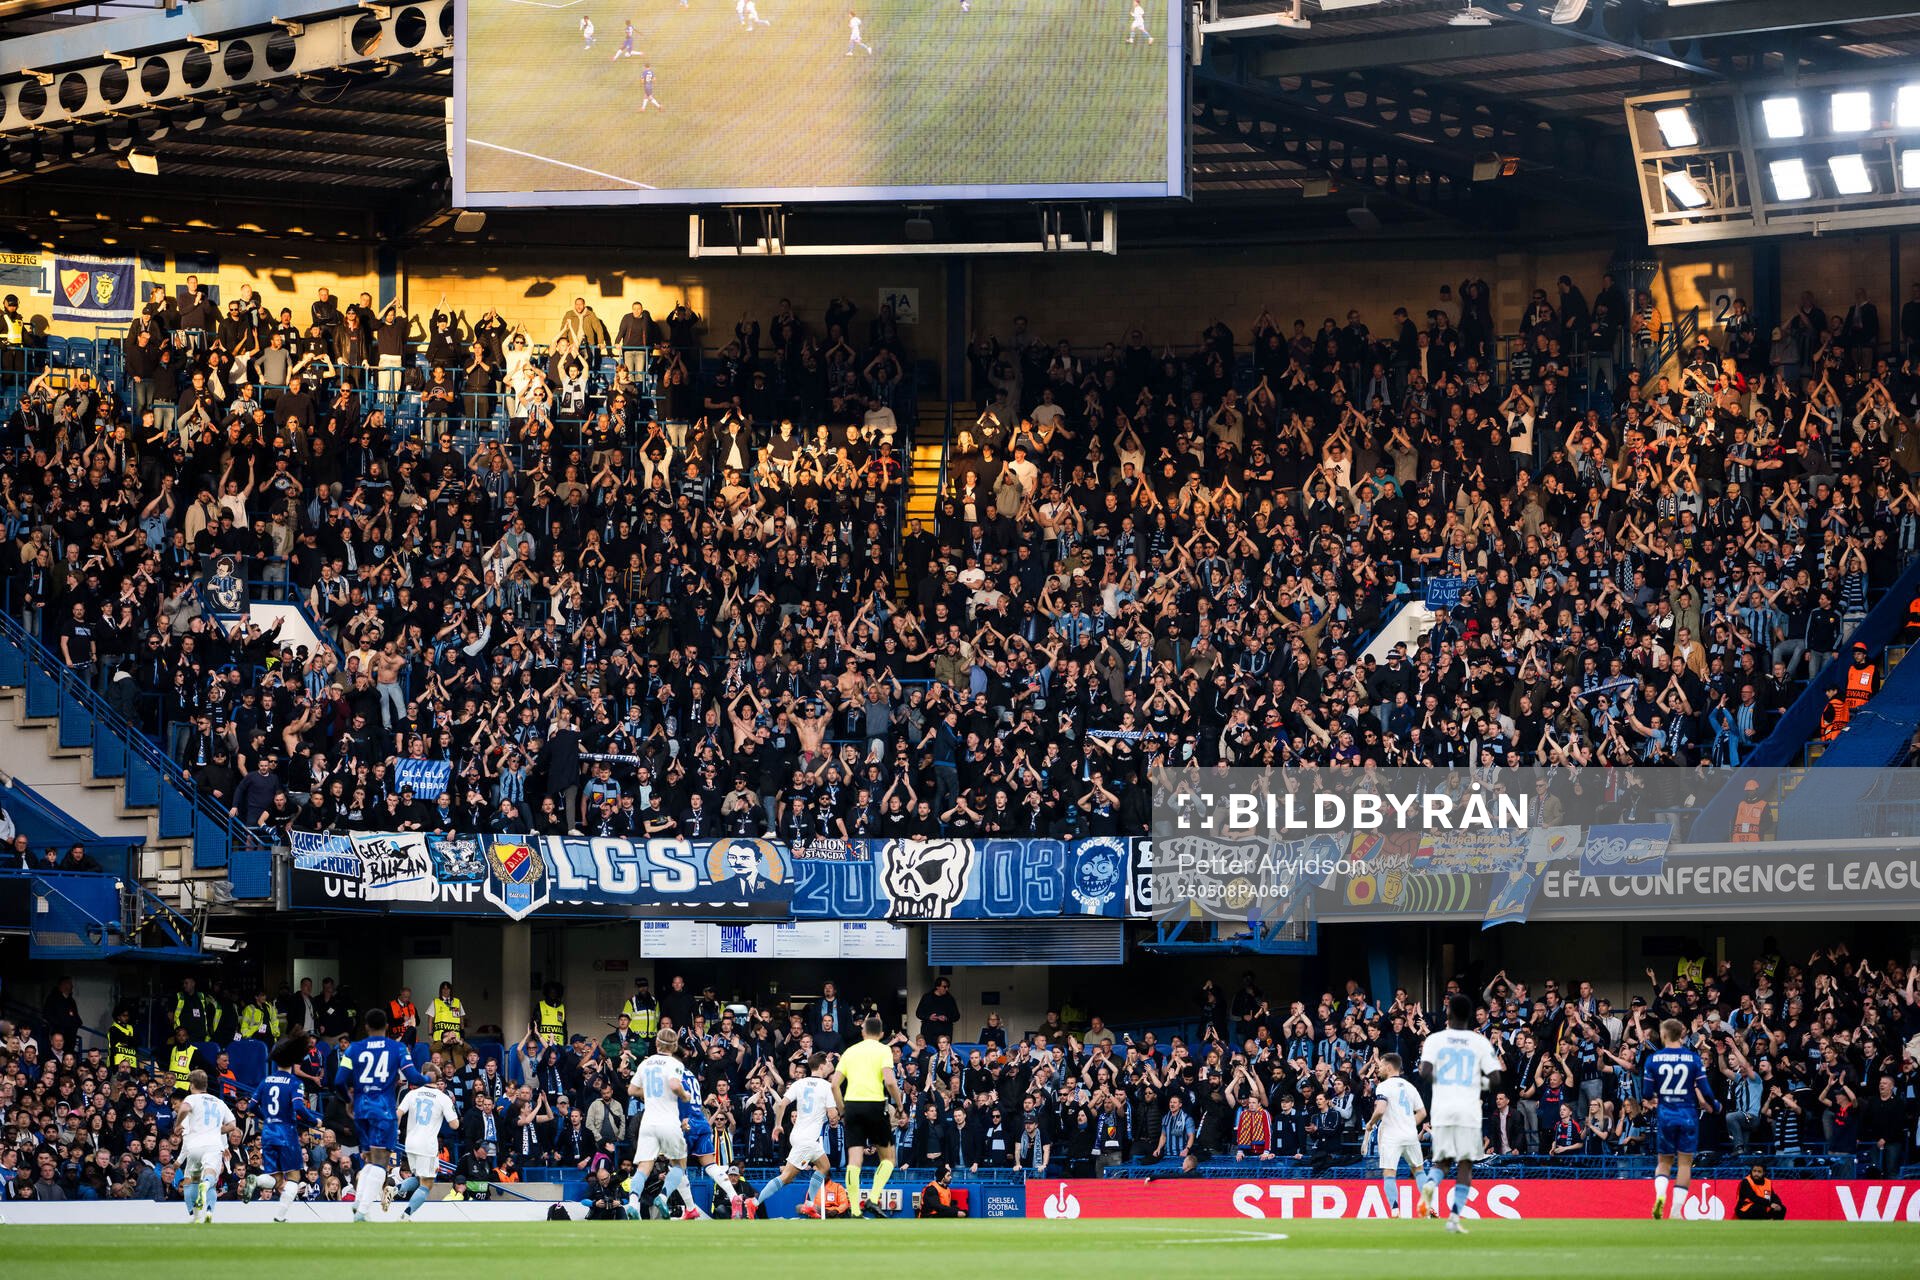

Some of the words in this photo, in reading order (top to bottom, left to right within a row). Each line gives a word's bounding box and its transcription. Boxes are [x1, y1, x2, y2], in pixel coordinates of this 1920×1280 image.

[0, 254, 37, 264] YBERG
[1715, 294, 1731, 323] 2
[402, 768, 421, 778] BLÅ
[425, 769, 444, 779] BLÅ
[367, 854, 427, 885] BALKAN
[1543, 870, 1601, 898] EFA
[1608, 863, 1815, 898] CONFERENCE
[1827, 860, 1920, 891] LEAGU
[732, 939, 757, 953] HOME
[358, 1051, 390, 1084] 24
[1437, 1047, 1475, 1087] 20
[1658, 1063, 1689, 1095] 22
[645, 1067, 664, 1098] 16
[686, 1077, 702, 1105] 19
[203, 1101, 221, 1127] 14
[267, 1085, 280, 1116] 3
[415, 1098, 434, 1126] 13
[802, 1087, 815, 1114] 5
[1399, 1089, 1411, 1116] 4
